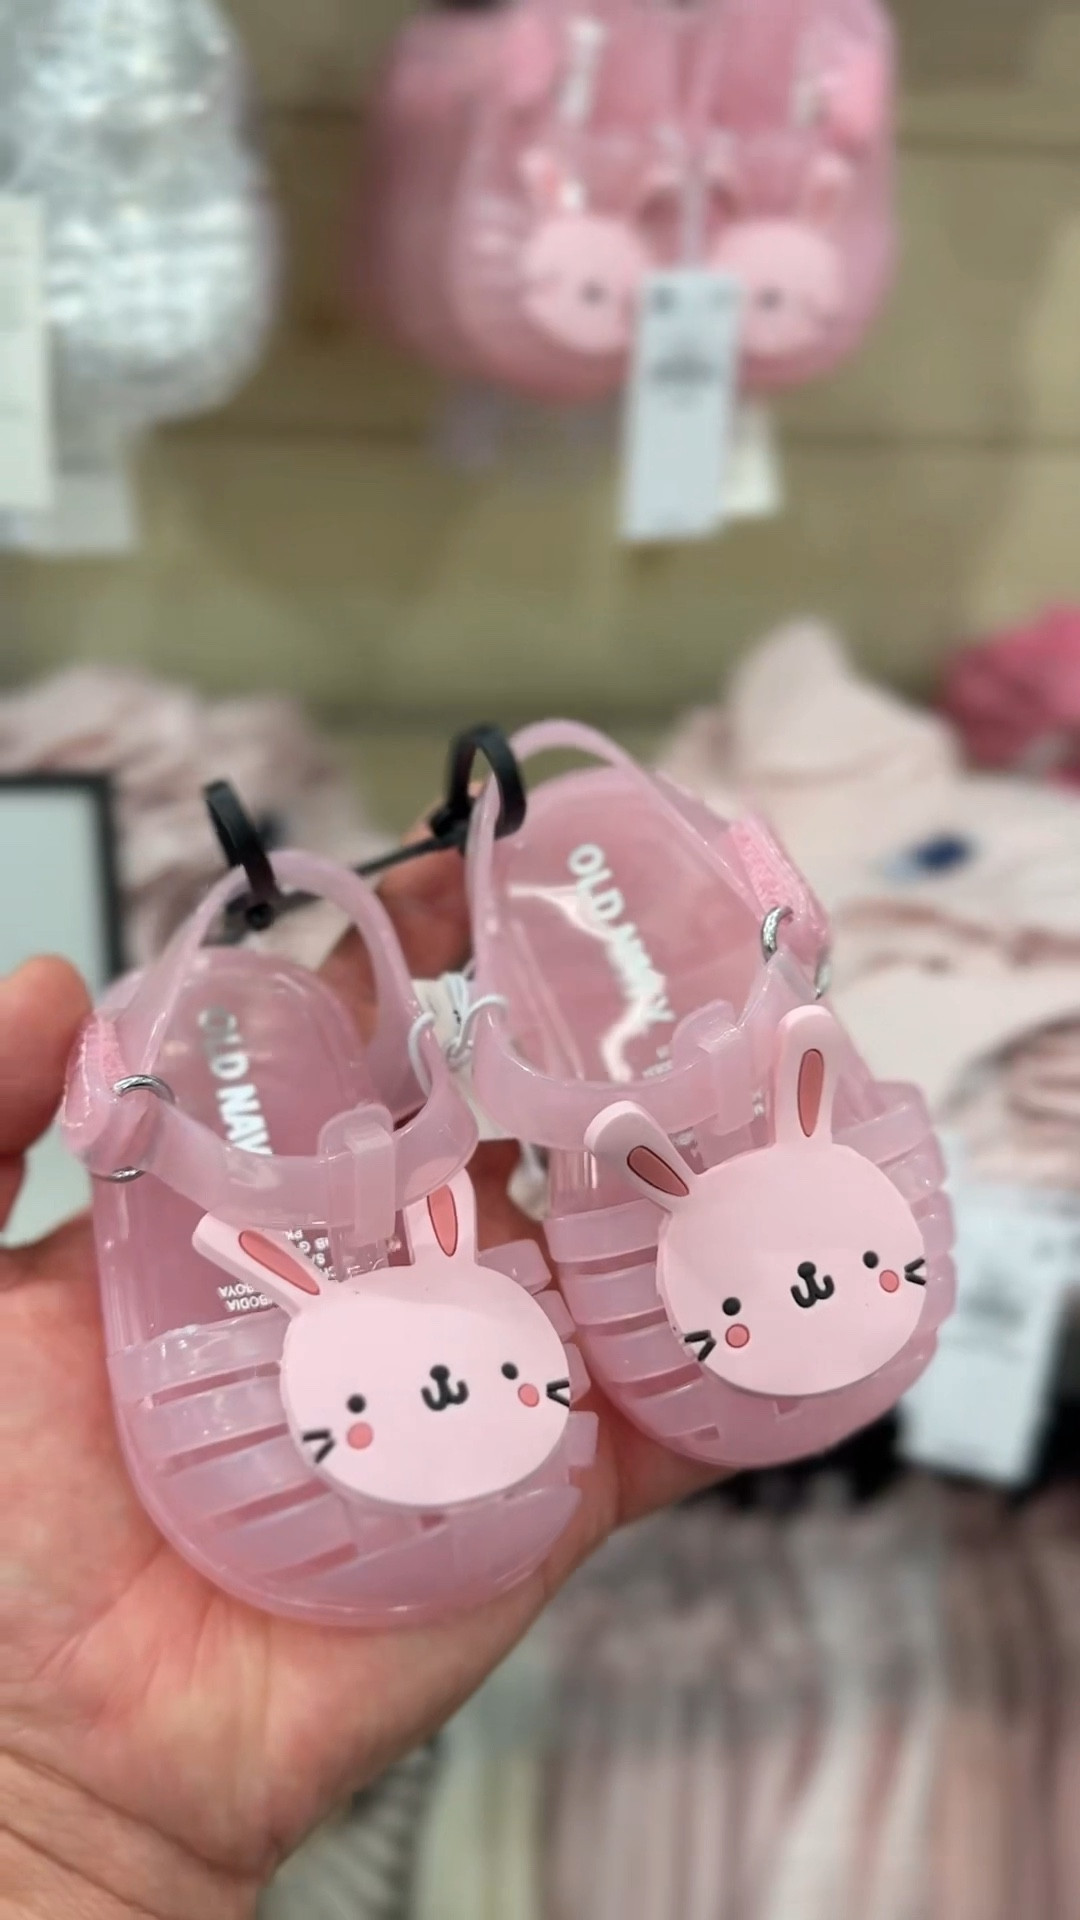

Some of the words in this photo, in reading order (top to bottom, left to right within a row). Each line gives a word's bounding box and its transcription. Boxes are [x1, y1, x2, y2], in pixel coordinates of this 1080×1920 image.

[568, 843, 625, 921] OLD
[199, 1006, 249, 1080] OLD
[216, 1083, 274, 1155] NAV
